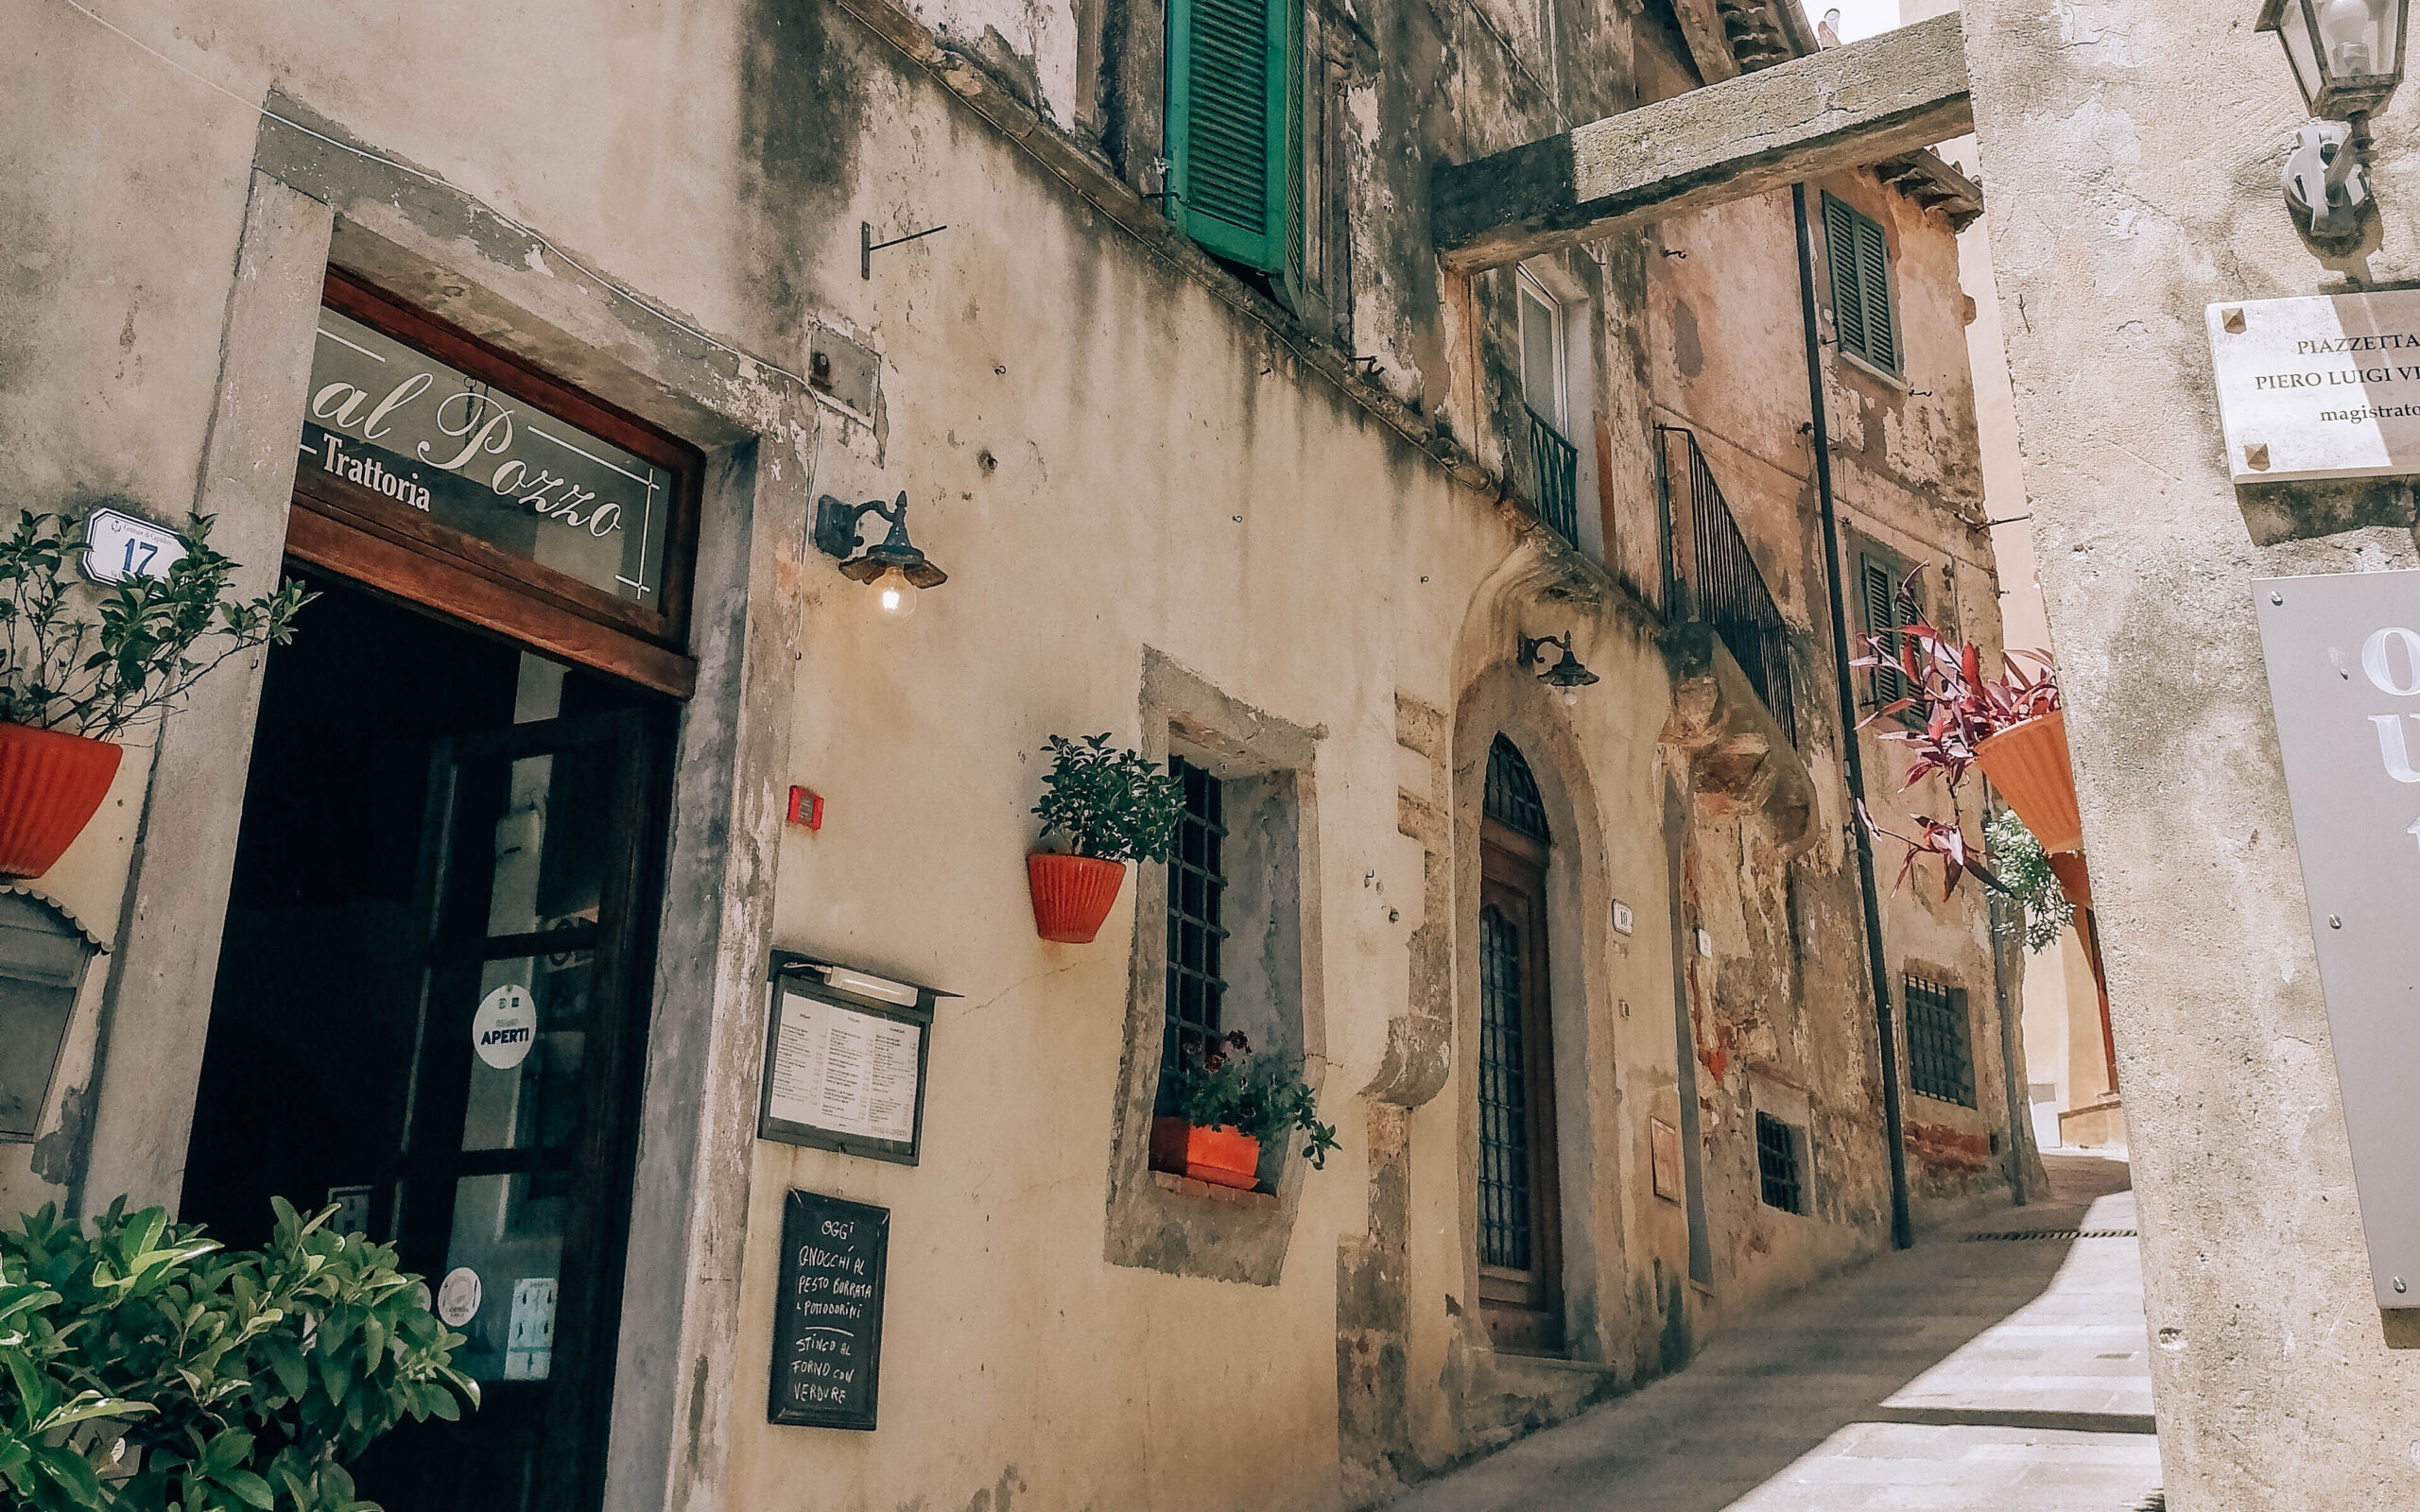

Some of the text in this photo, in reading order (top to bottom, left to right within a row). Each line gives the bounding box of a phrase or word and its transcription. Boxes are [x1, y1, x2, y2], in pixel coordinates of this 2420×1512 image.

[2297, 334, 2420, 354] PIAZZETTA
[2255, 372, 2323, 390] PIERO
[2327, 368, 2393, 386] LUIGI
[2320, 404, 2420, 424] magistrato
[312, 372, 622, 538] al Pozzo
[323, 433, 430, 512] Trattoria
[123, 538, 159, 576] 17
[480, 1027, 529, 1046] APERTI
[853, 1257, 865, 1276] AL
[798, 1275, 830, 1295] PESTO
[839, 1342, 852, 1356] AL
[791, 1359, 855, 1383] FORNO CON
[794, 1383, 846, 1405] VERDURE
